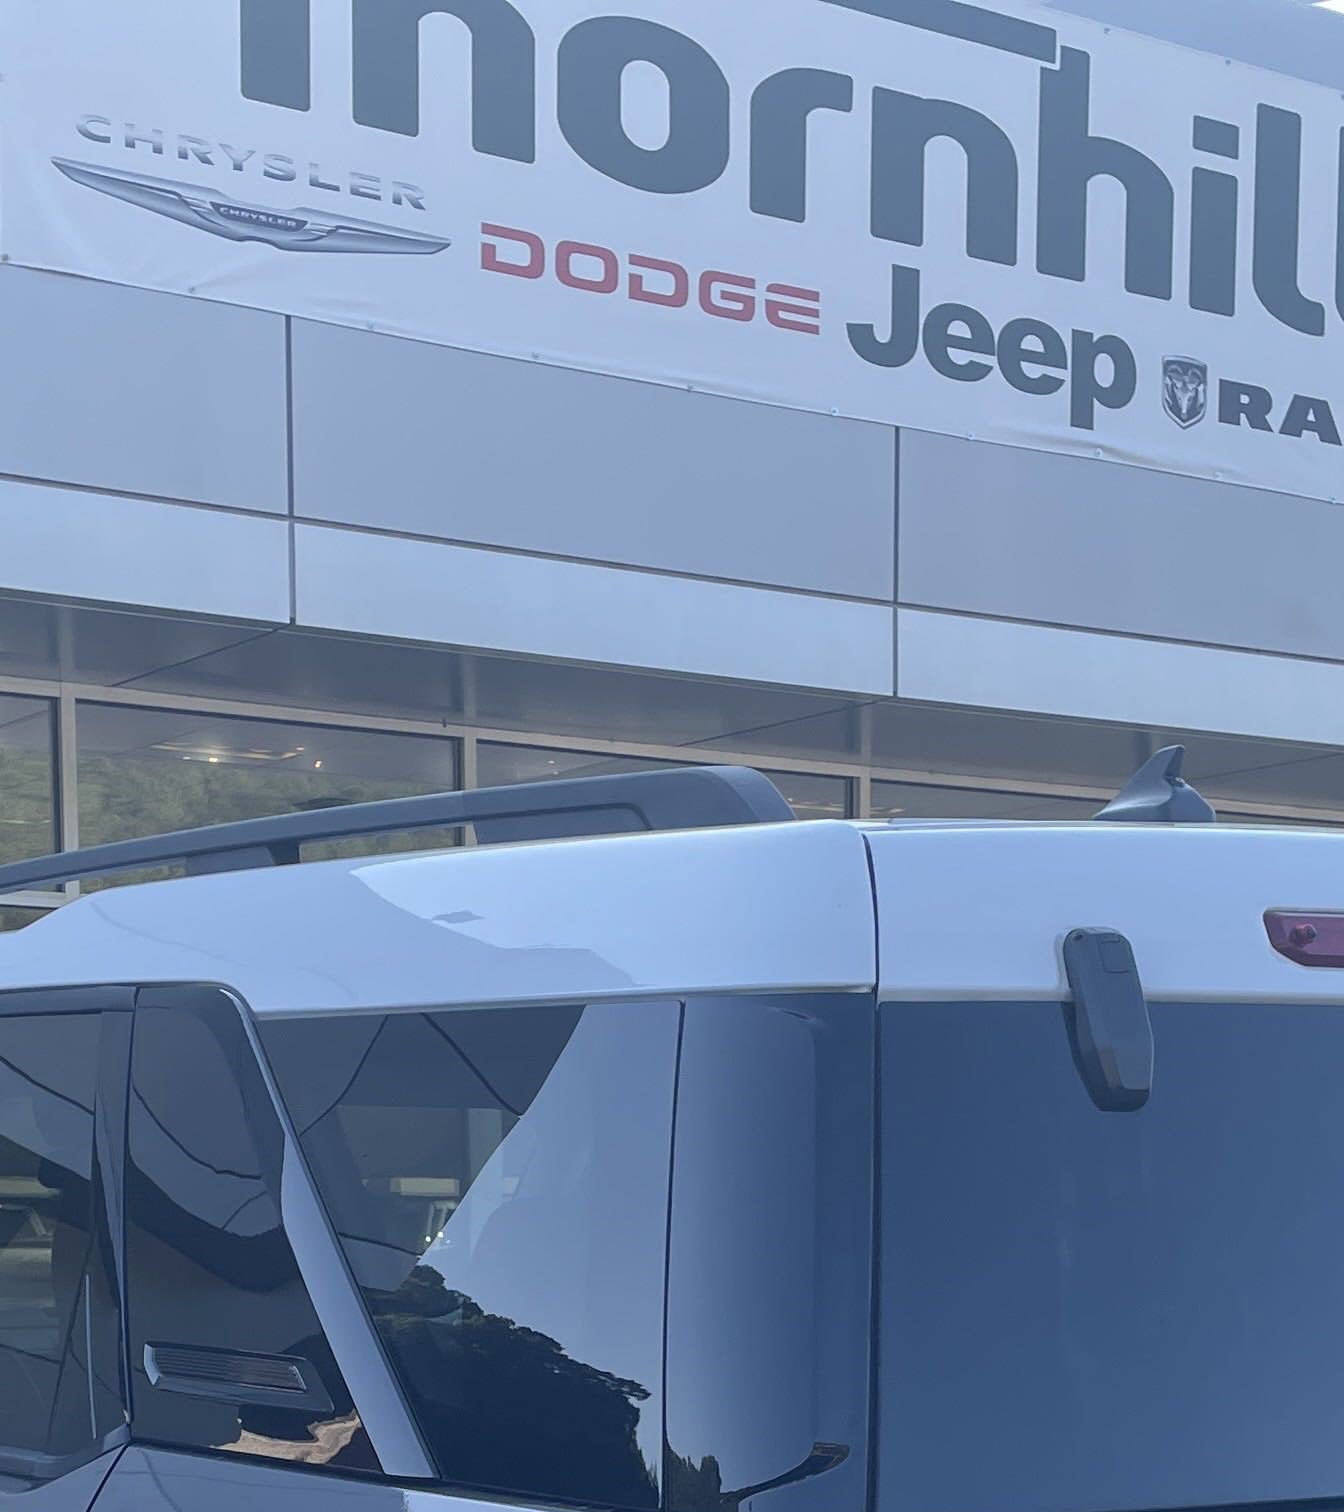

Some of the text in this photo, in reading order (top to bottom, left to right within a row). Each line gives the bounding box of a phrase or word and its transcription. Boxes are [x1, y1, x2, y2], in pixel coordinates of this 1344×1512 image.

[75, 114, 427, 211] CHRYSLER
[218, 206, 298, 228] CHRYSLER
[479, 222, 821, 336] DODGE
[845, 263, 1137, 431] Jeep
